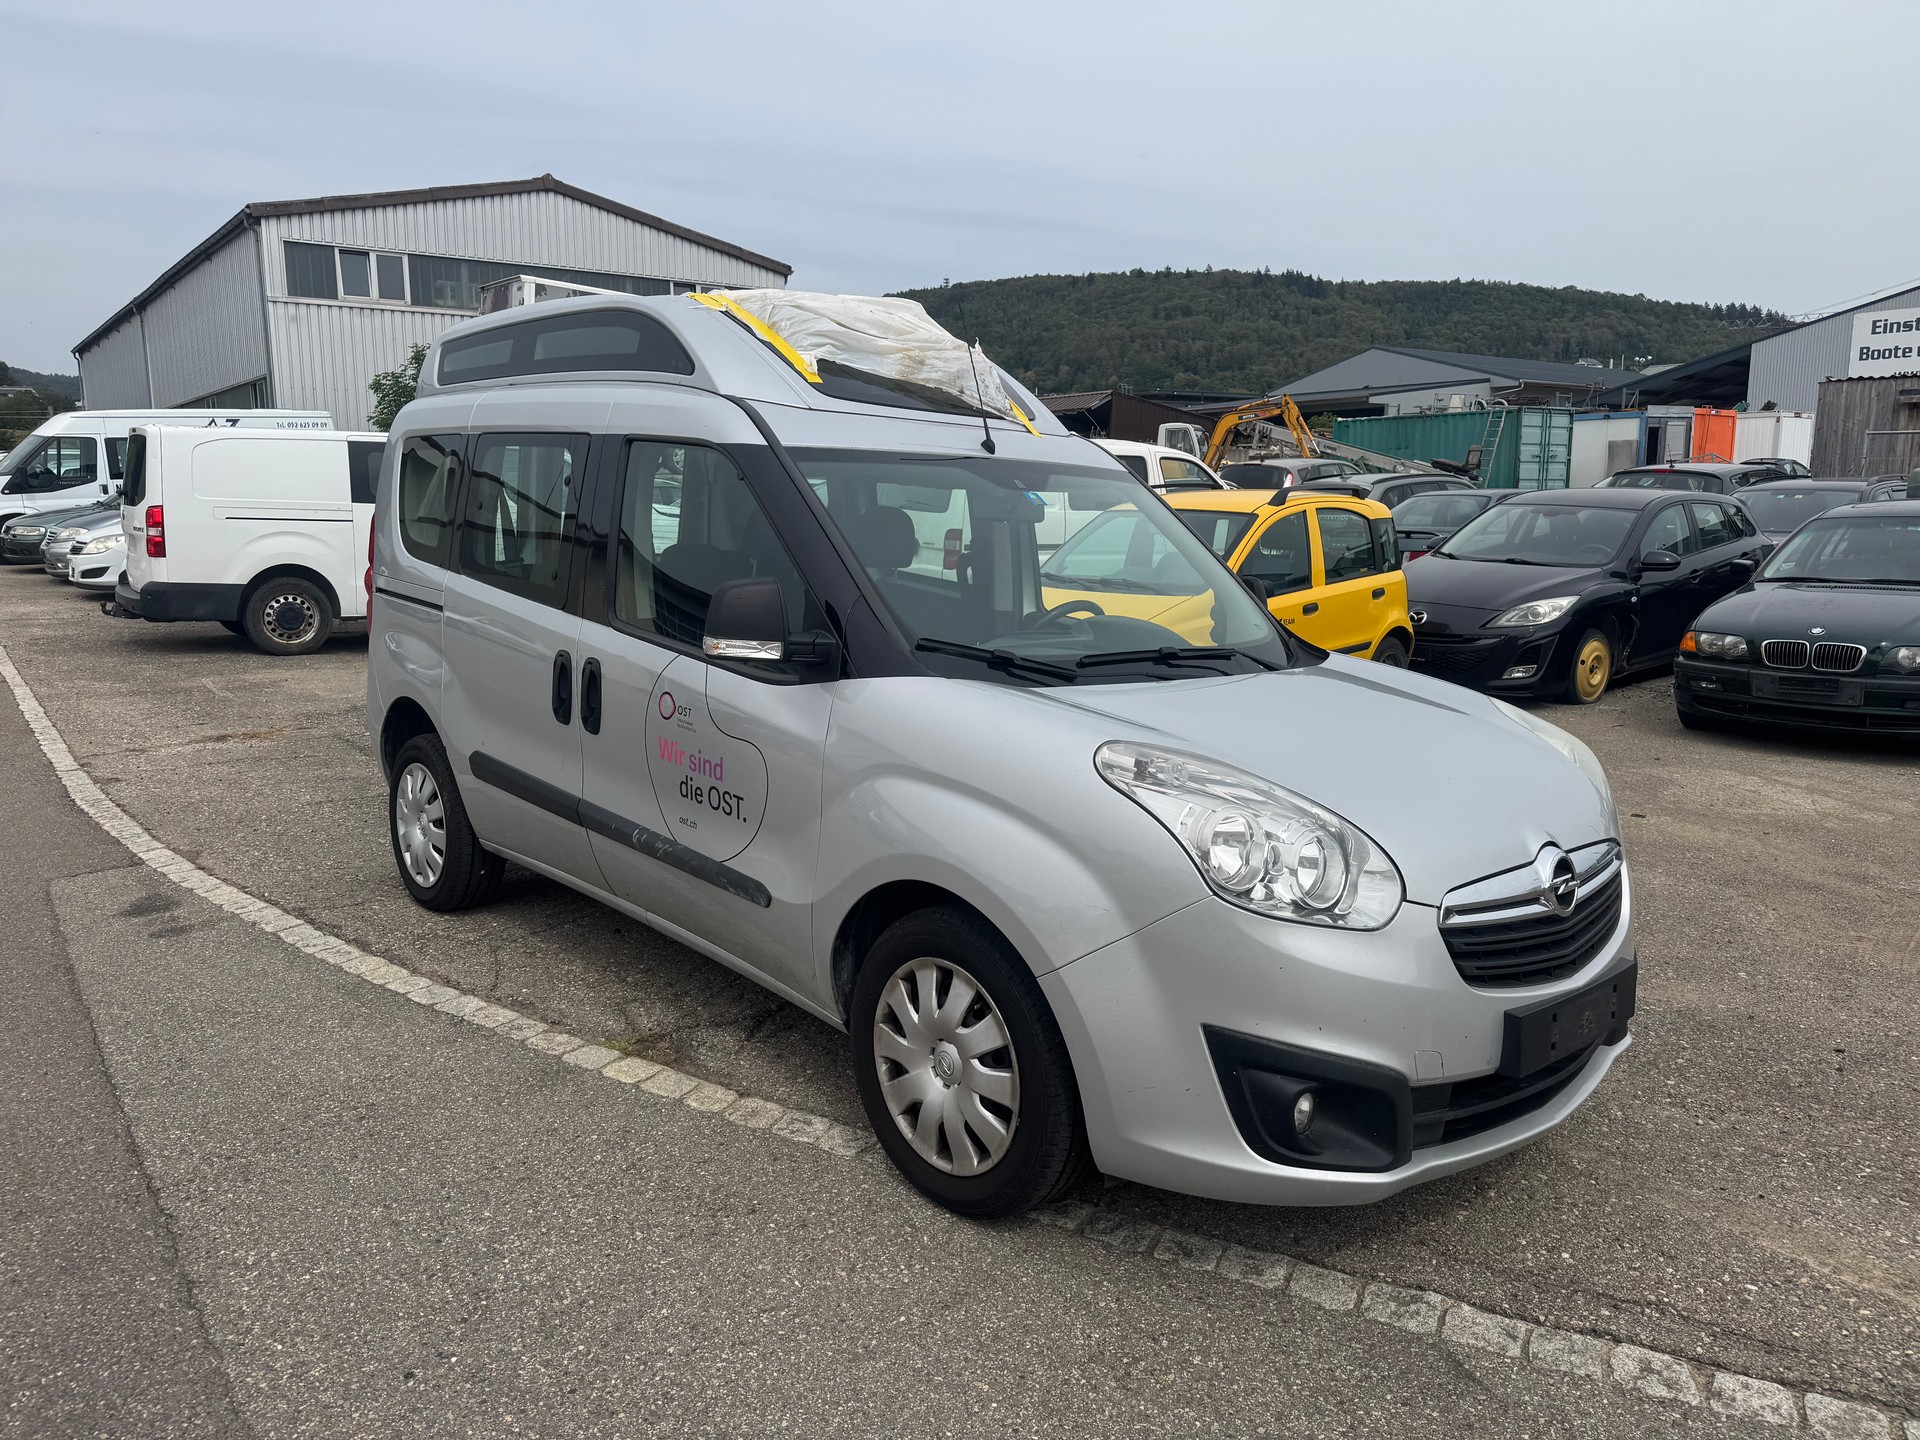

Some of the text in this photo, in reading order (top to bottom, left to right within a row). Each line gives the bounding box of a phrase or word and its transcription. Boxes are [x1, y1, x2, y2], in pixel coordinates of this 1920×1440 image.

[1858, 345, 1913, 362] Boote
[677, 704, 692, 718] OST
[658, 735, 724, 782] Wir sind
[679, 775, 747, 823] die OST.
[678, 815, 698, 830] ost.ch
